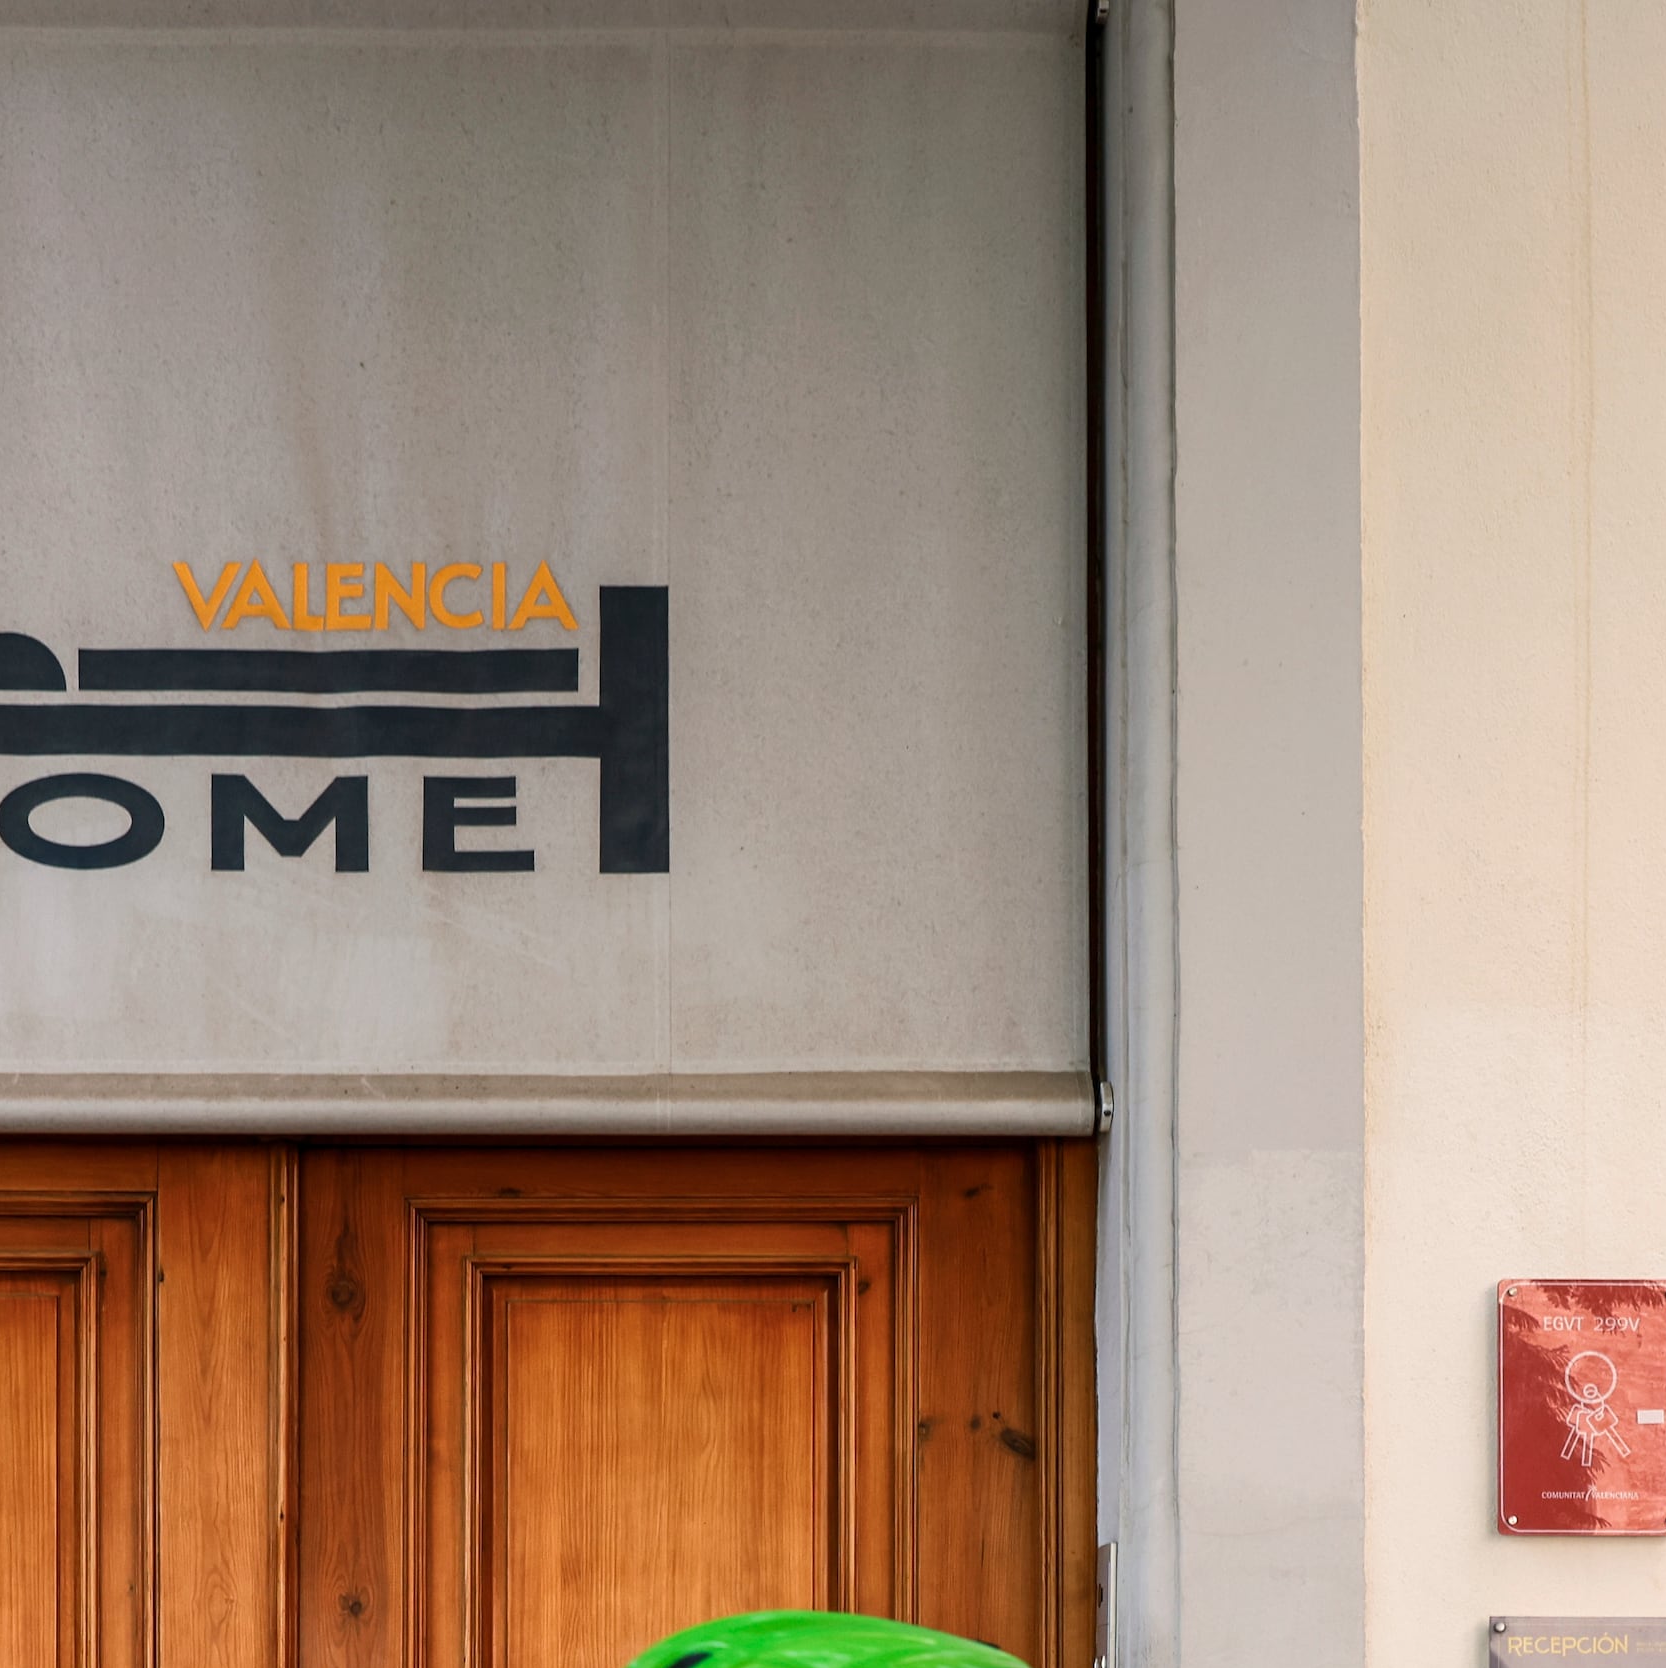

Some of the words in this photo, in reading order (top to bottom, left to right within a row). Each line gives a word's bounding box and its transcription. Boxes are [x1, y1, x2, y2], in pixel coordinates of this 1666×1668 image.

[173, 560, 579, 632] VALENCIA
[1543, 1316, 1585, 1332] EGVT
[1593, 1316, 1641, 1332] 299V
[1541, 1491, 1586, 1500] COMUNITAT
[1591, 1491, 1639, 1500] VALENCIANA
[1507, 1632, 1629, 1657] RECEPCIÓN
